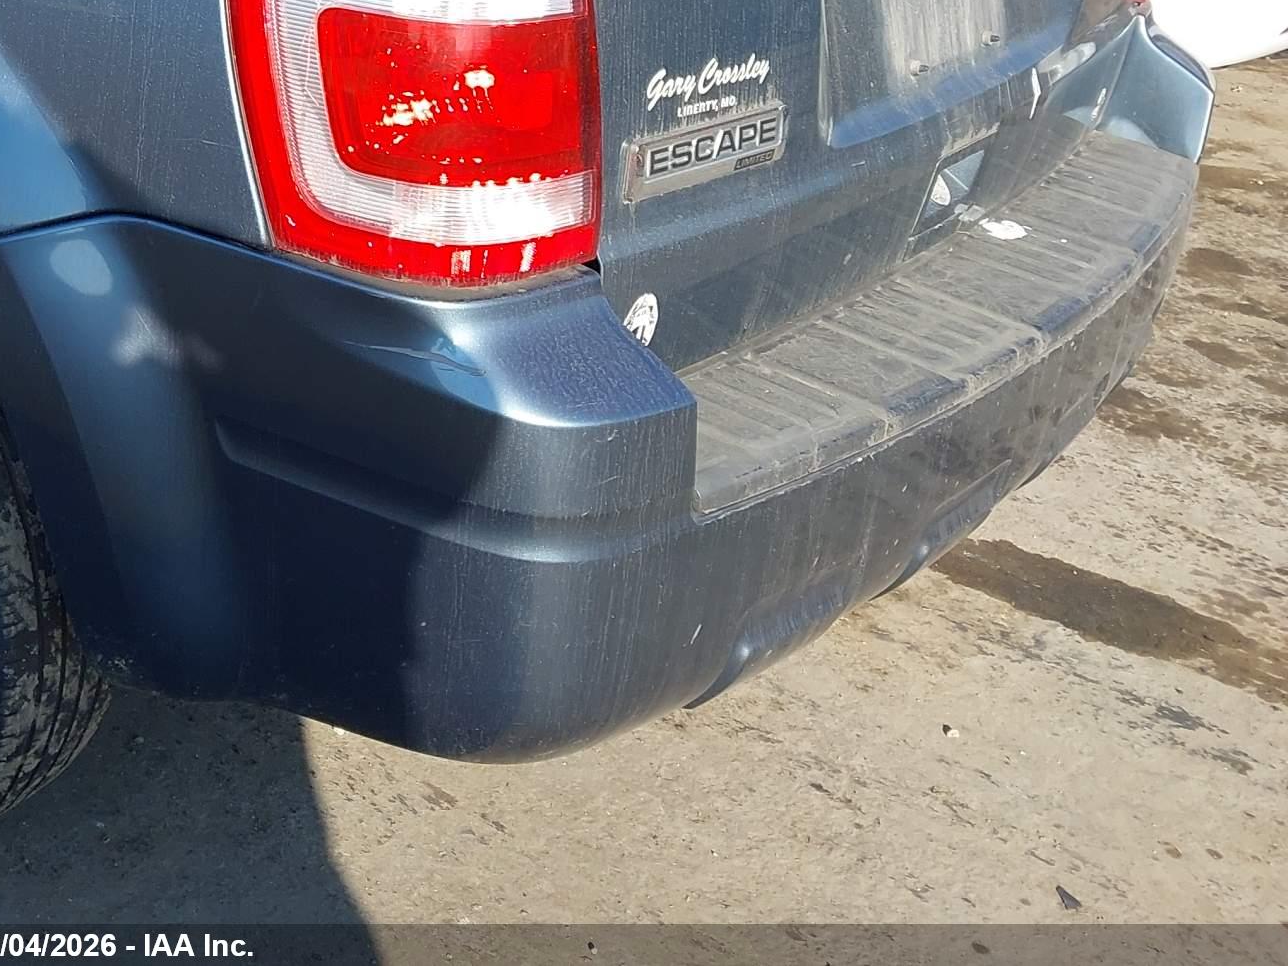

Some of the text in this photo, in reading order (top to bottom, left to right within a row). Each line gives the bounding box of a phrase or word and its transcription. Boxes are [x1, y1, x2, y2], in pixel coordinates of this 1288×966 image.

[646, 53, 771, 111] Gary Crossley
[646, 117, 778, 177] ESCAPE
[735, 151, 773, 169] LIMITED
